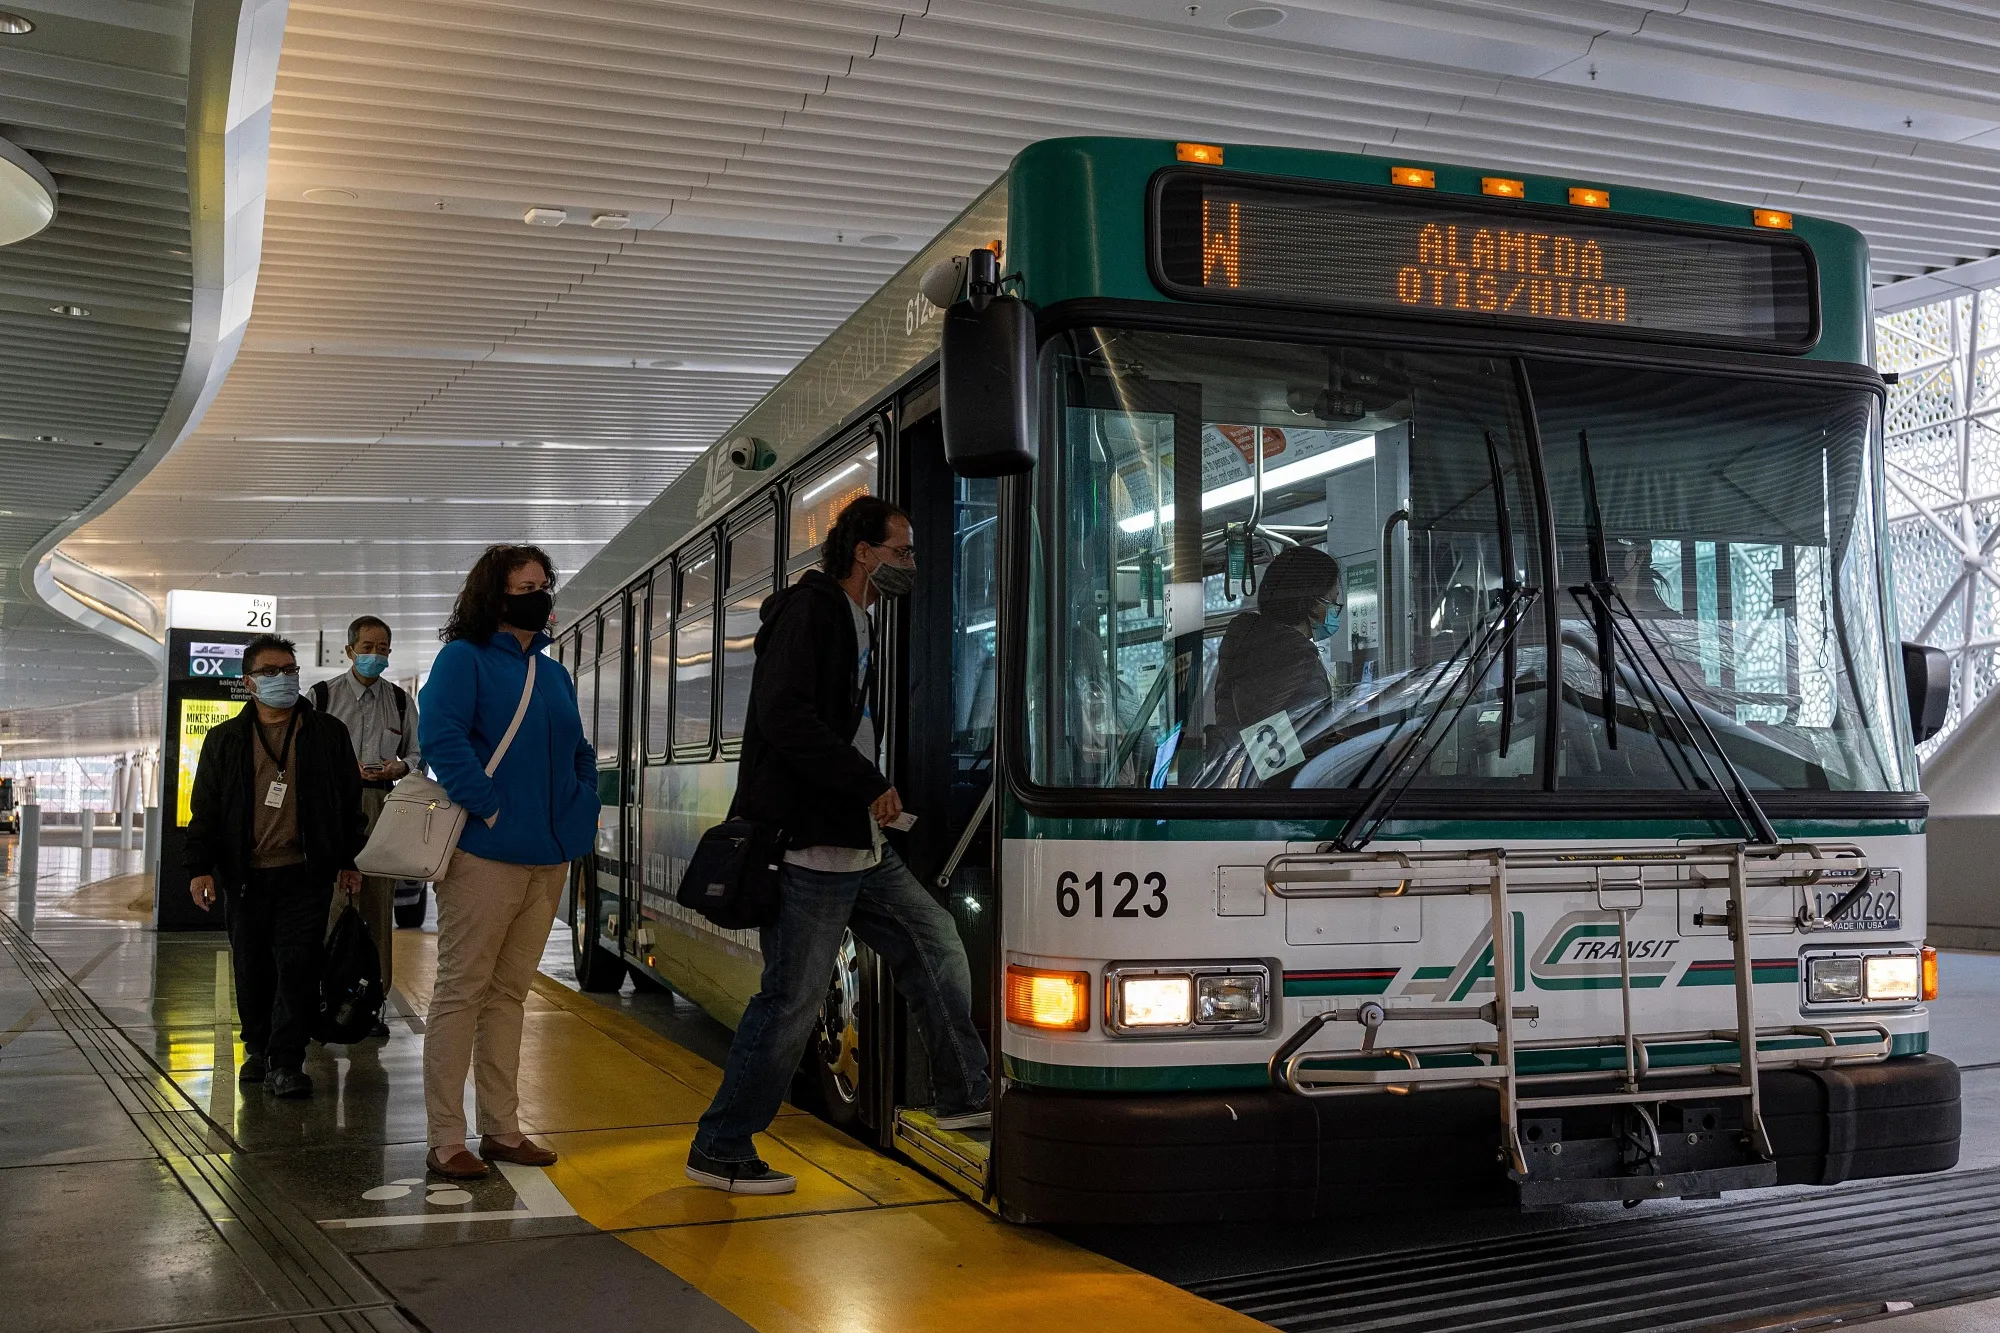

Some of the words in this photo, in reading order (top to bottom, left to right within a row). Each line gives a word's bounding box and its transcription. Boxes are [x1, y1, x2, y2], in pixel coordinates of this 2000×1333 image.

[1202, 200, 1239, 287] W
[1418, 223, 1603, 279] ALAMEDA
[1398, 266, 1627, 322] OTIS/HIGH
[818, 307, 893, 416] LOCALLY
[253, 599, 273, 609] Bay
[246, 611, 272, 628] 26
[192, 658, 224, 675] OX
[219, 679, 244, 688] salesfo
[186, 713, 209, 723] MIKE'S
[186, 725, 212, 735] LEMON
[1257, 724, 1287, 769] 3
[1056, 870, 1169, 918] 6123
[1830, 922, 1854, 930] MADE
[1866, 921, 1883, 929] USA
[1572, 939, 1680, 961] TRANSIT
